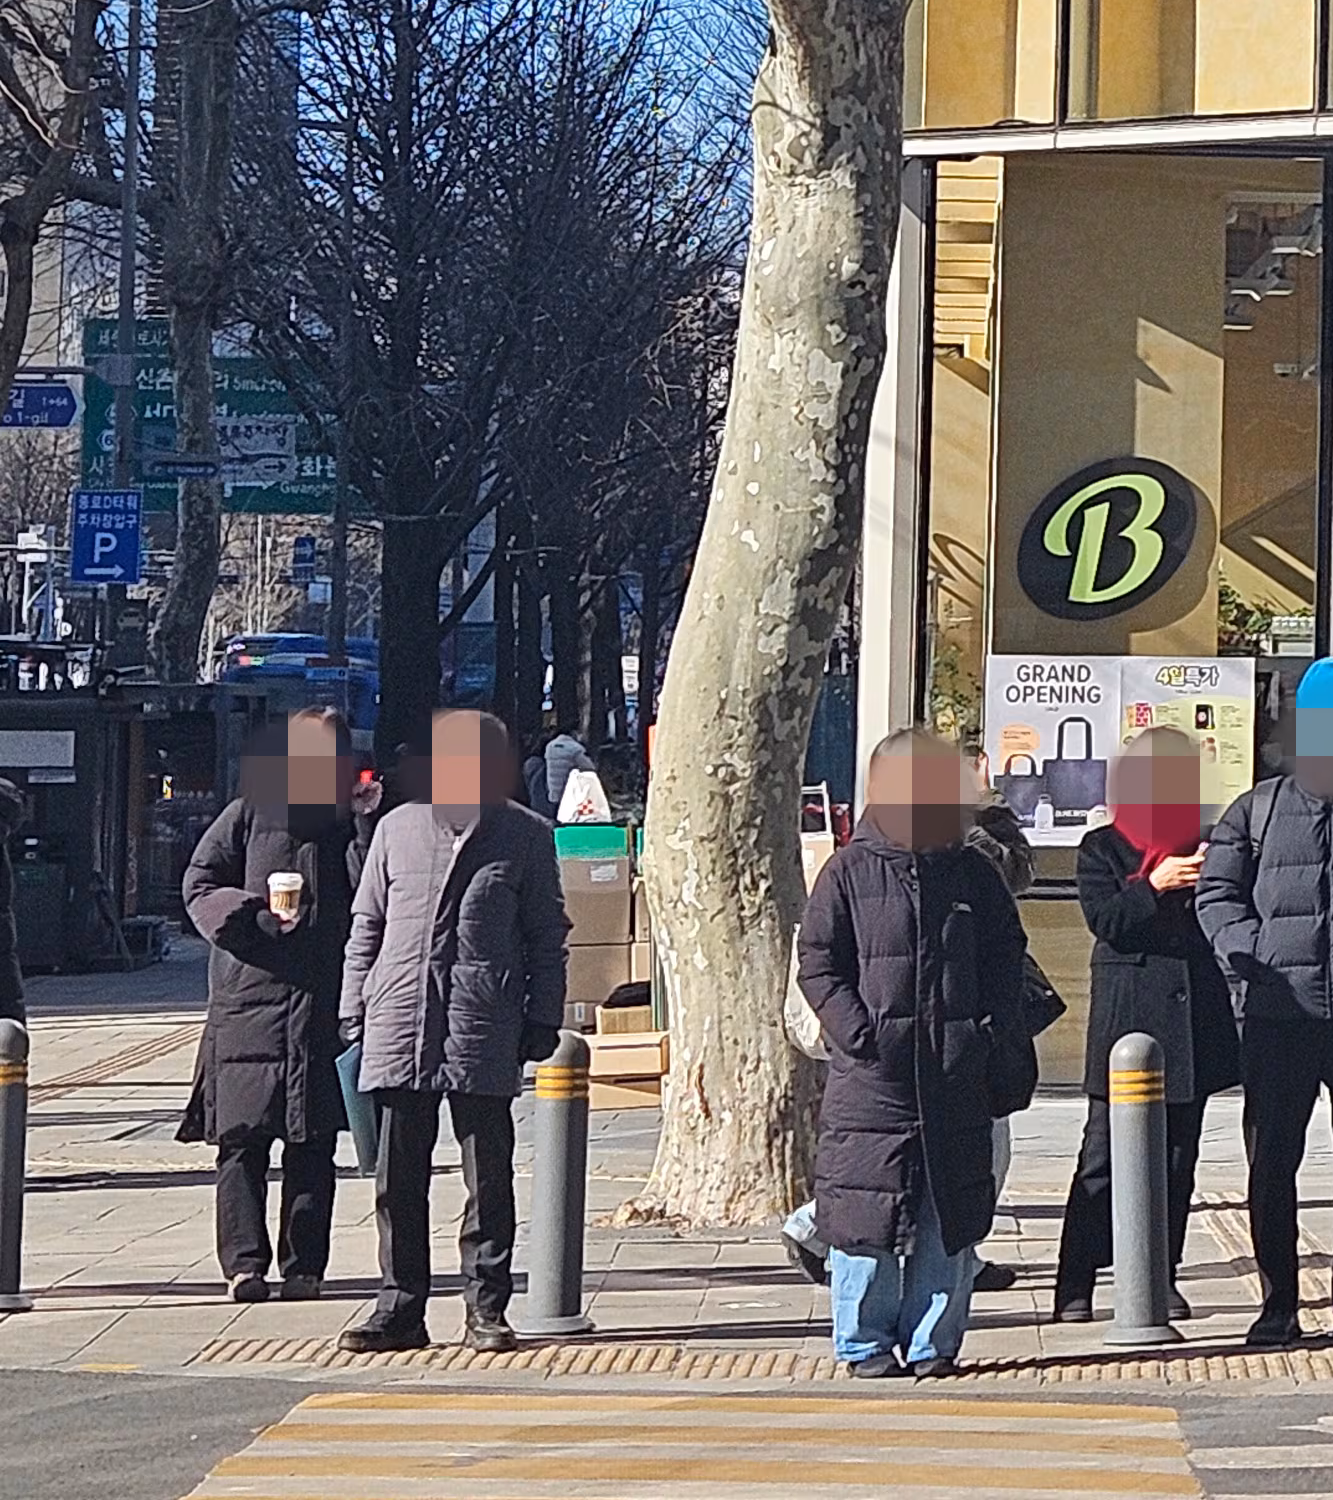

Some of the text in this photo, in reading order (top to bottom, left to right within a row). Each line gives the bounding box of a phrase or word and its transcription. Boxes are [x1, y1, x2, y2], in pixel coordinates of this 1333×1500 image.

[94, 531, 118, 564] P
[1043, 473, 1166, 604] B
[1016, 664, 1092, 683] GRAND
[1005, 684, 1102, 704] OPENING
